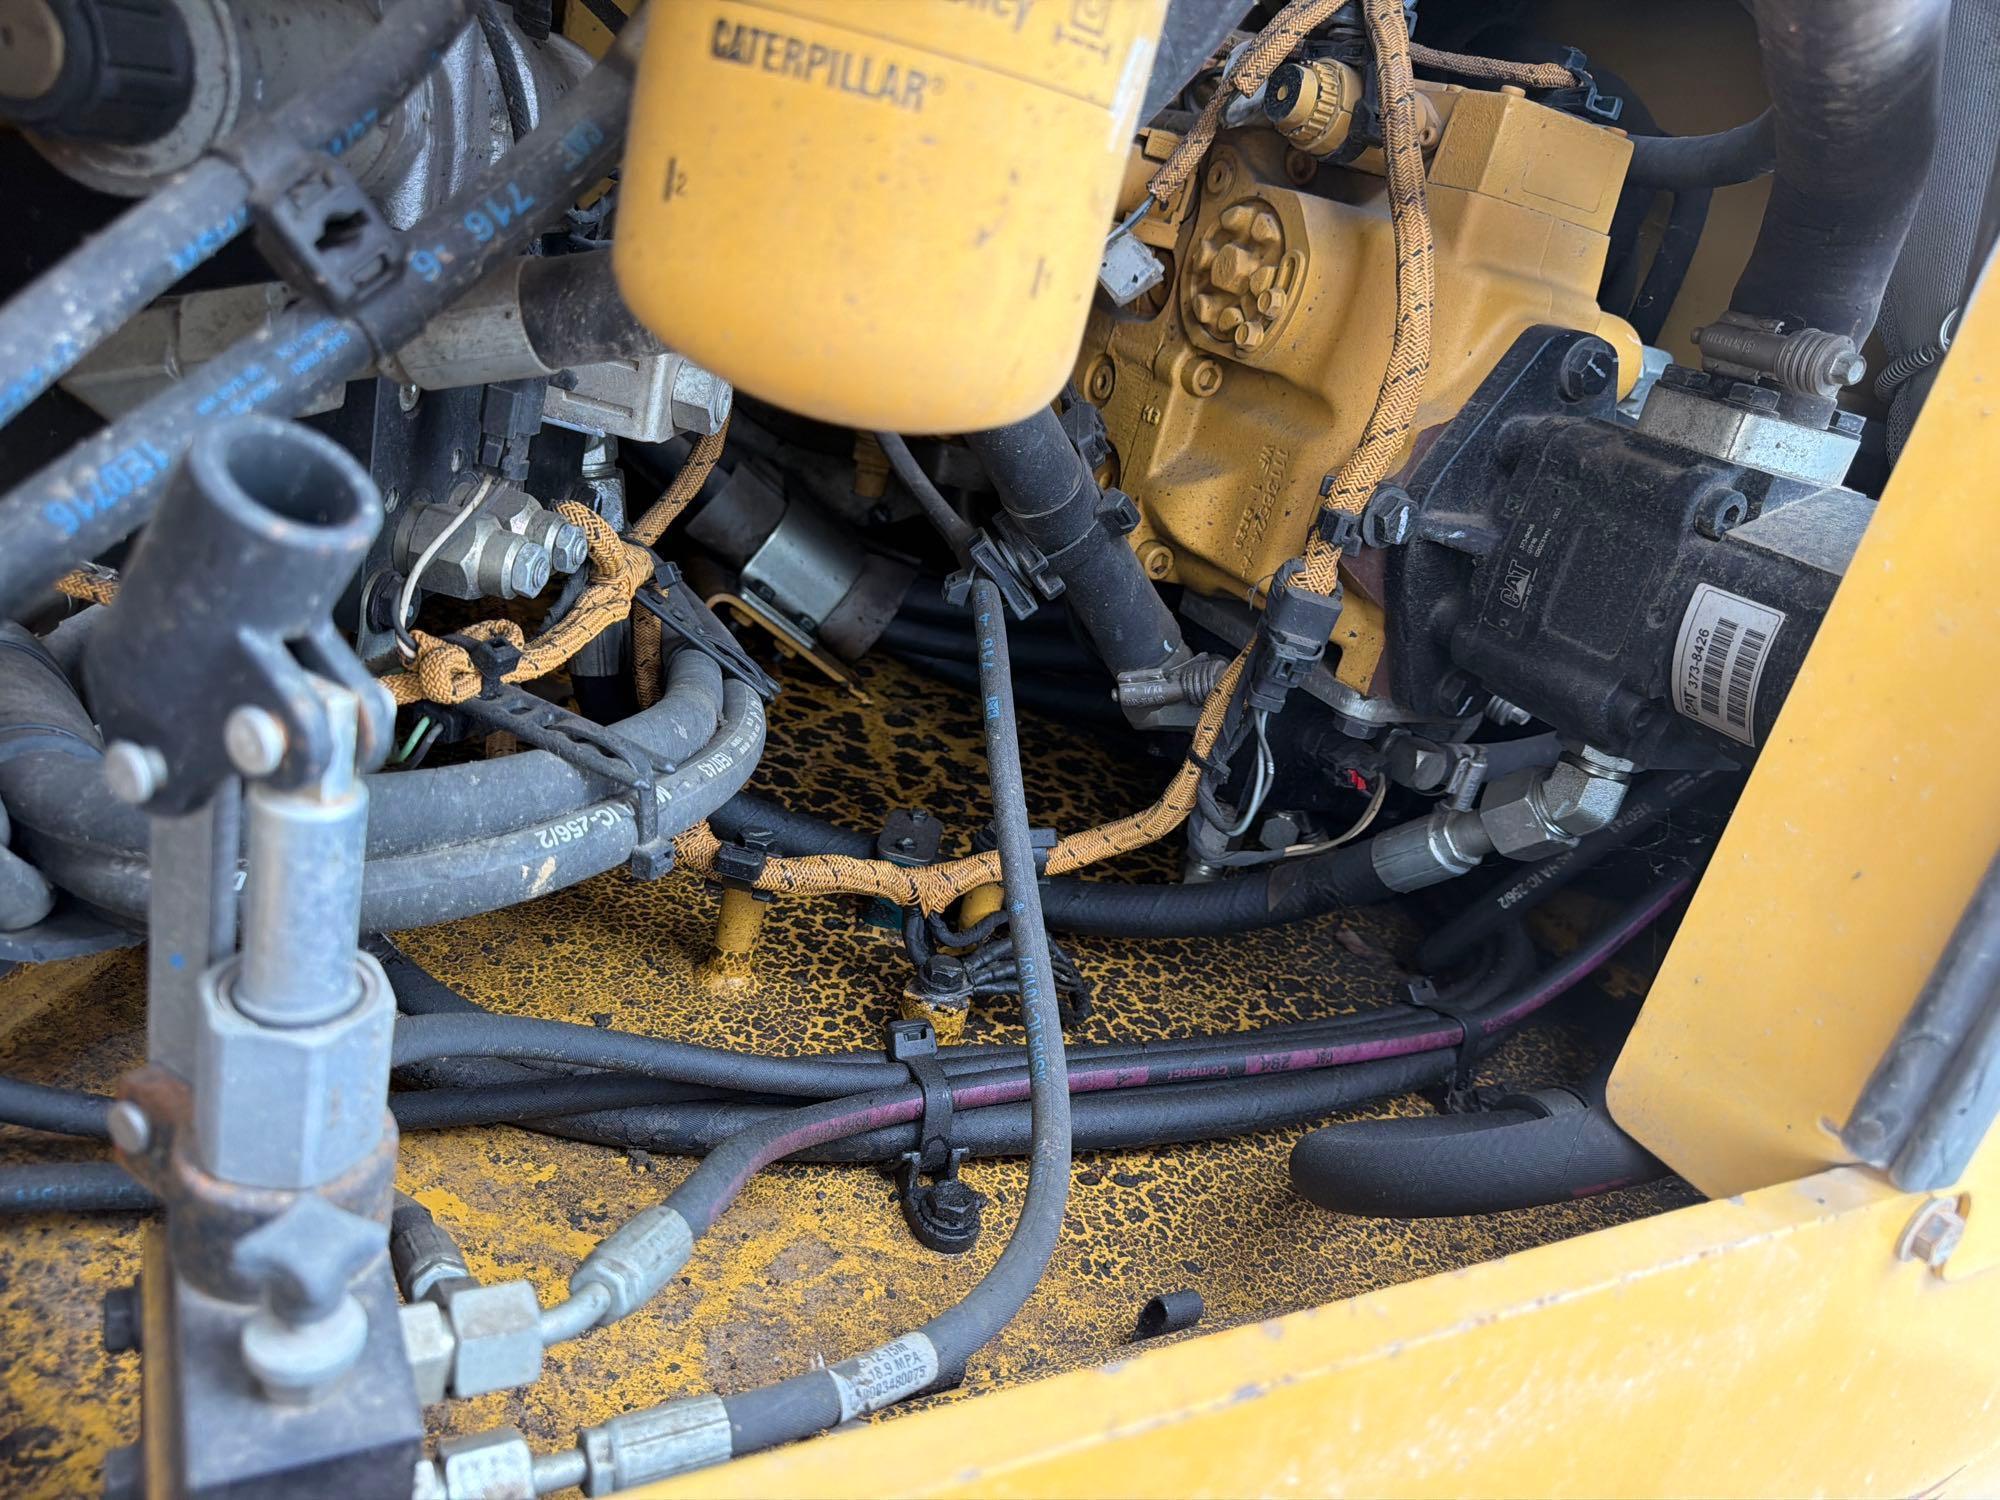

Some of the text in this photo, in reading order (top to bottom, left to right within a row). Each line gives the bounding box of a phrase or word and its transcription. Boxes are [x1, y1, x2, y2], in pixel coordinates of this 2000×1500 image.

[710, 18, 930, 113] CATERPILLAR
[463, 181, 536, 242] 716
[1500, 559, 1531, 608] CAT
[1683, 628, 1710, 716] CAT 373-8426
[697, 751, 733, 778] 1E0743
